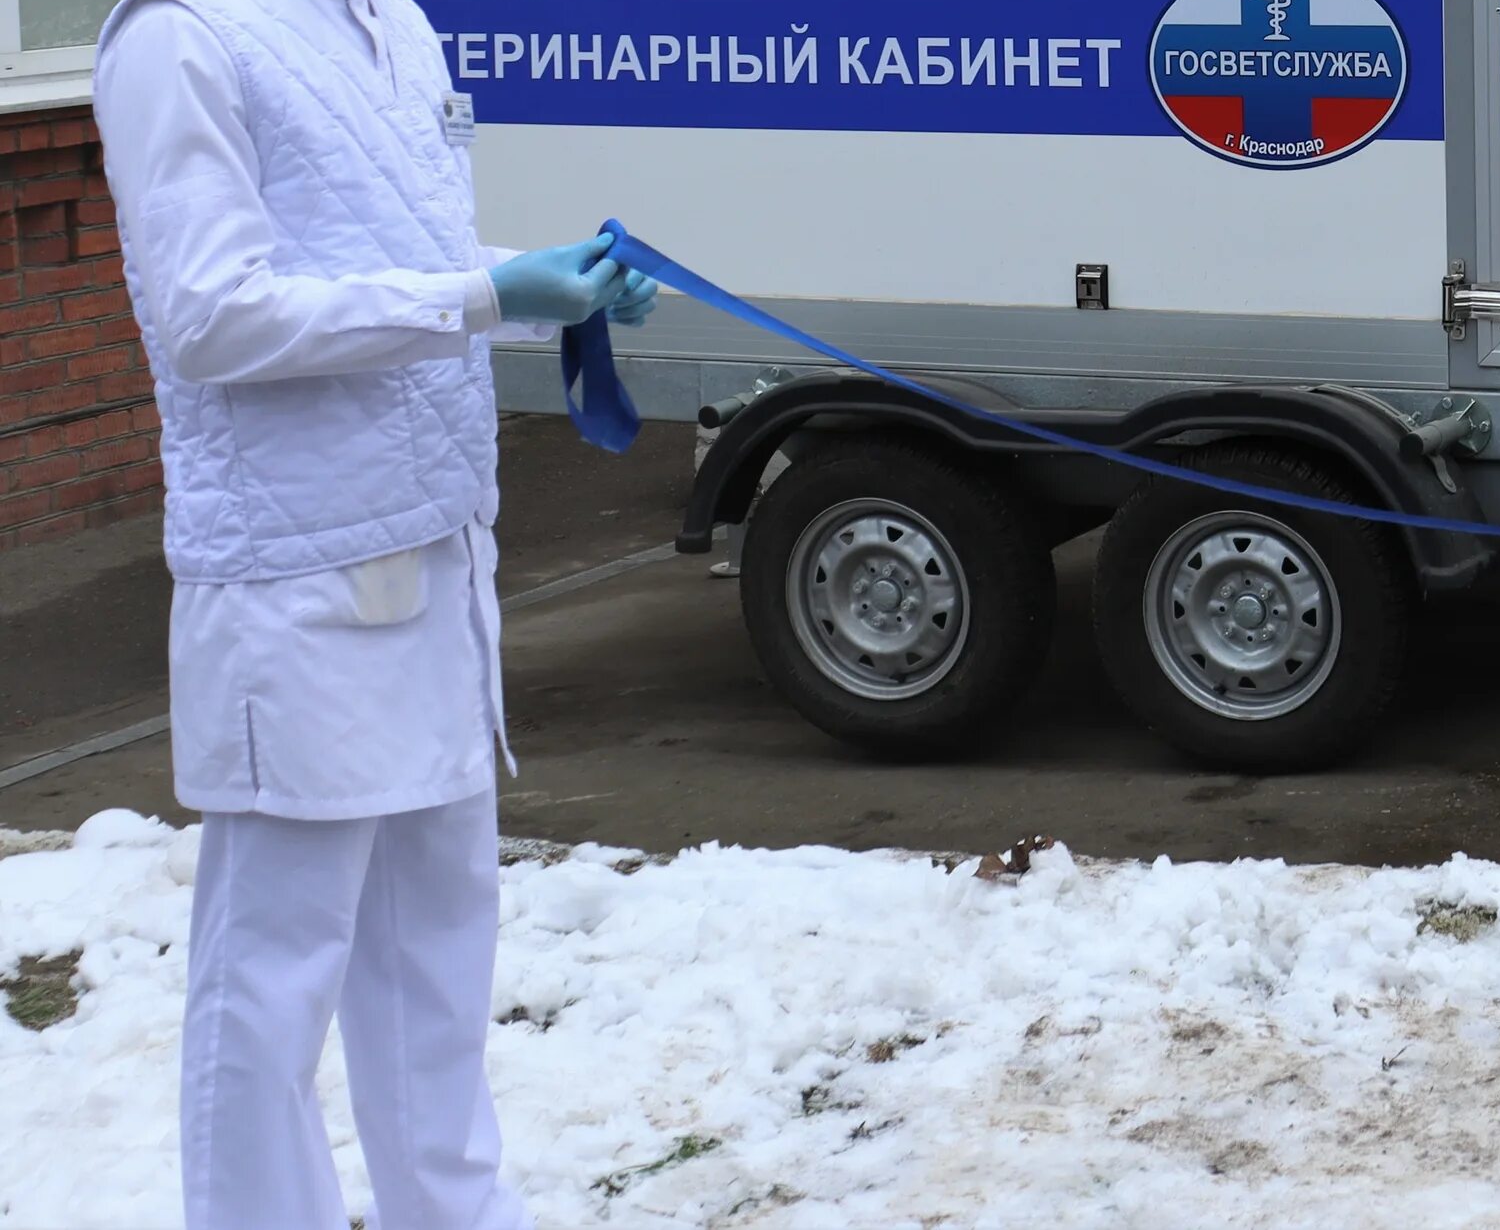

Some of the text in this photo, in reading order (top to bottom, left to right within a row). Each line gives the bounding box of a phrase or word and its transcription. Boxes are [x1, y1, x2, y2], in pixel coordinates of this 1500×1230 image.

[437, 23, 1122, 88] ЕРИНАРНЫЙ КАБИНЕТ
[1165, 50, 1392, 78] ГОСВЕТСЛУЖБА
[1225, 132, 1324, 157] г. Краснодар
